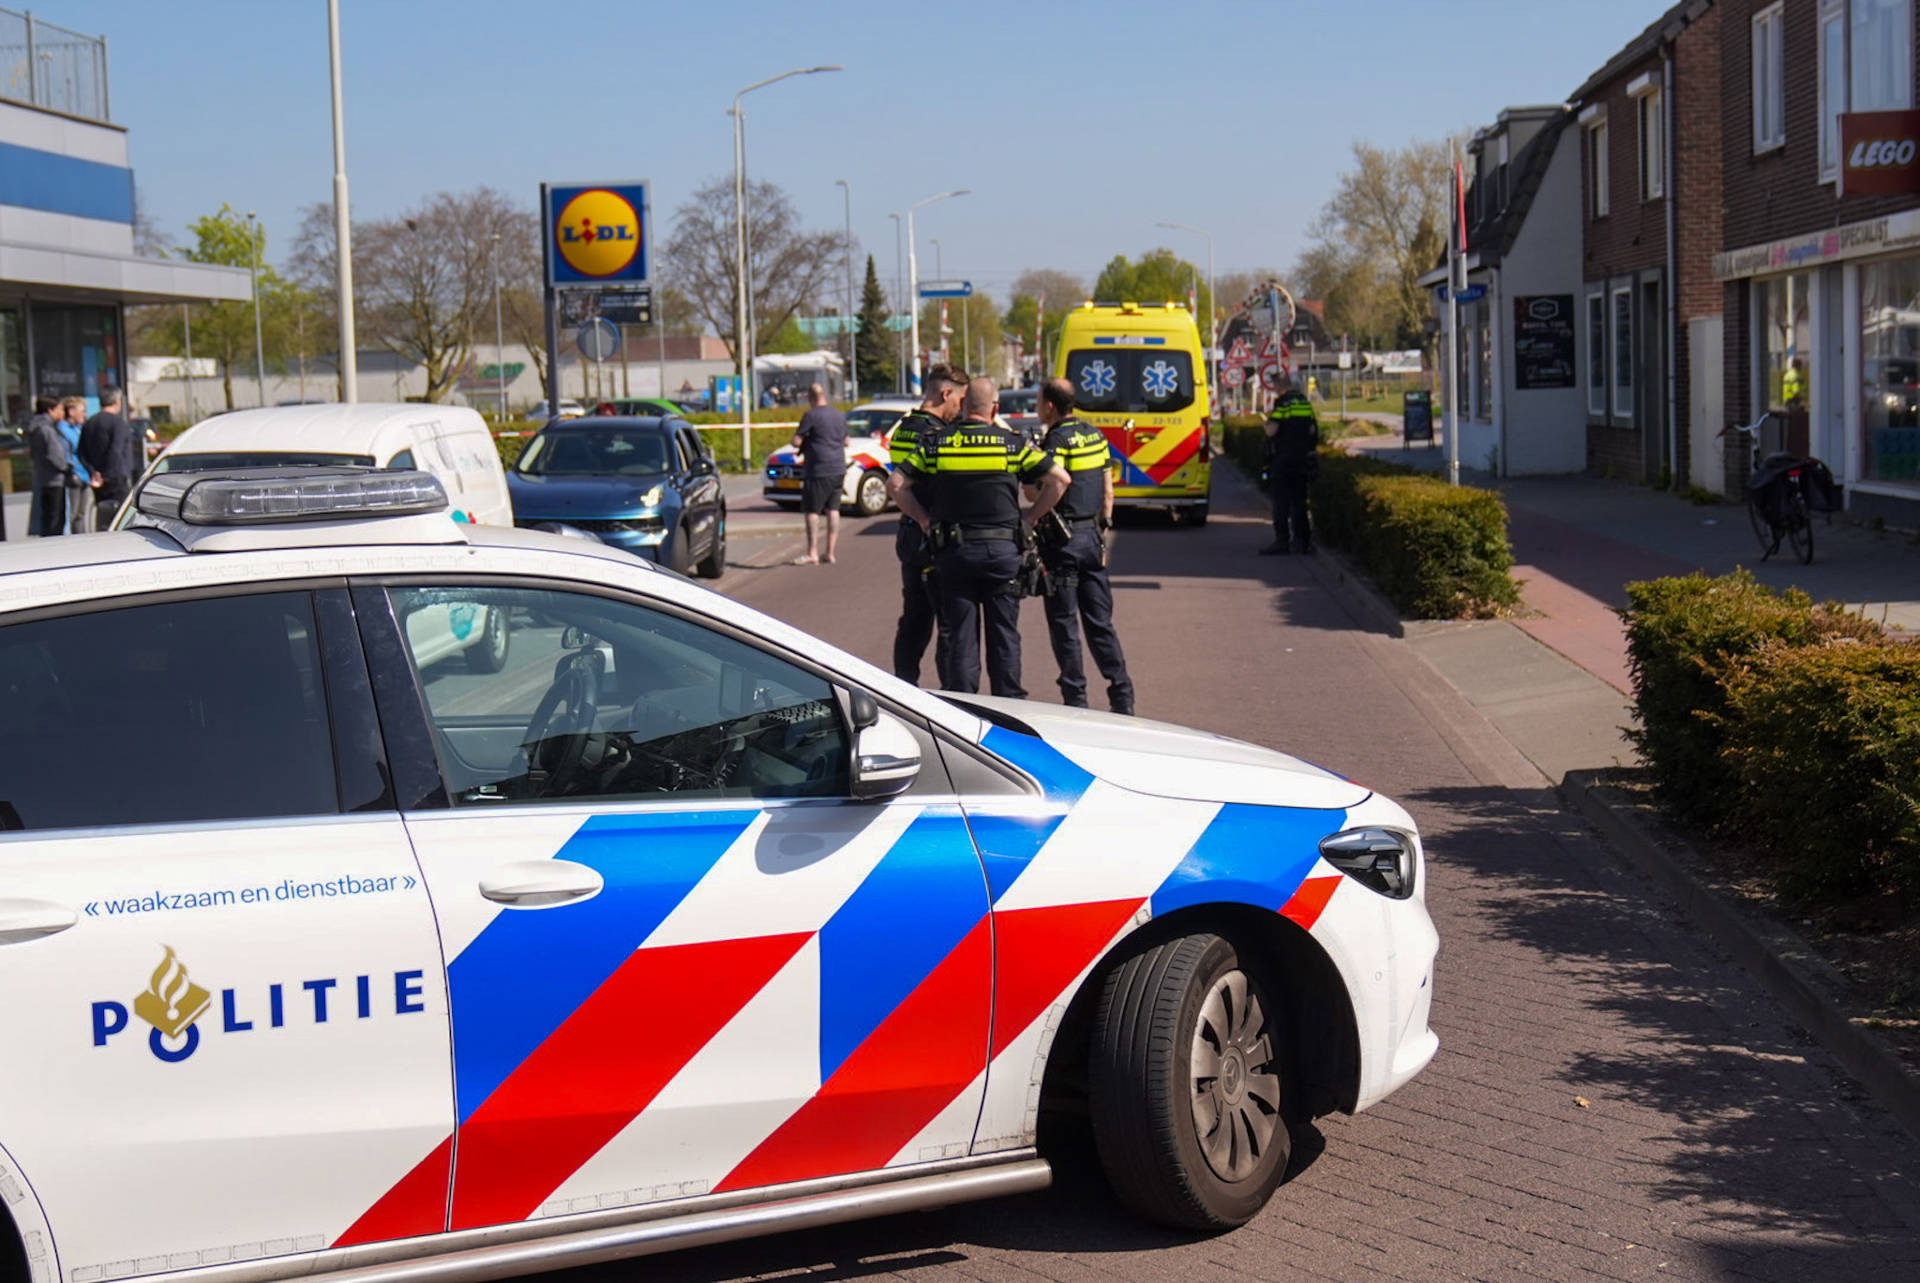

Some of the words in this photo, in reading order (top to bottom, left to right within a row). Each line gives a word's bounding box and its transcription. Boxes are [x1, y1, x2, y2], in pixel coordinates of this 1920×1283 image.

[1848, 139, 1916, 168] LEGO
[946, 434, 997, 448] POLITIE
[104, 890, 236, 916] waakzaam
[240, 886, 270, 904] en
[275, 874, 397, 901] dienstbaar
[91, 968, 425, 1063] POLITIE
